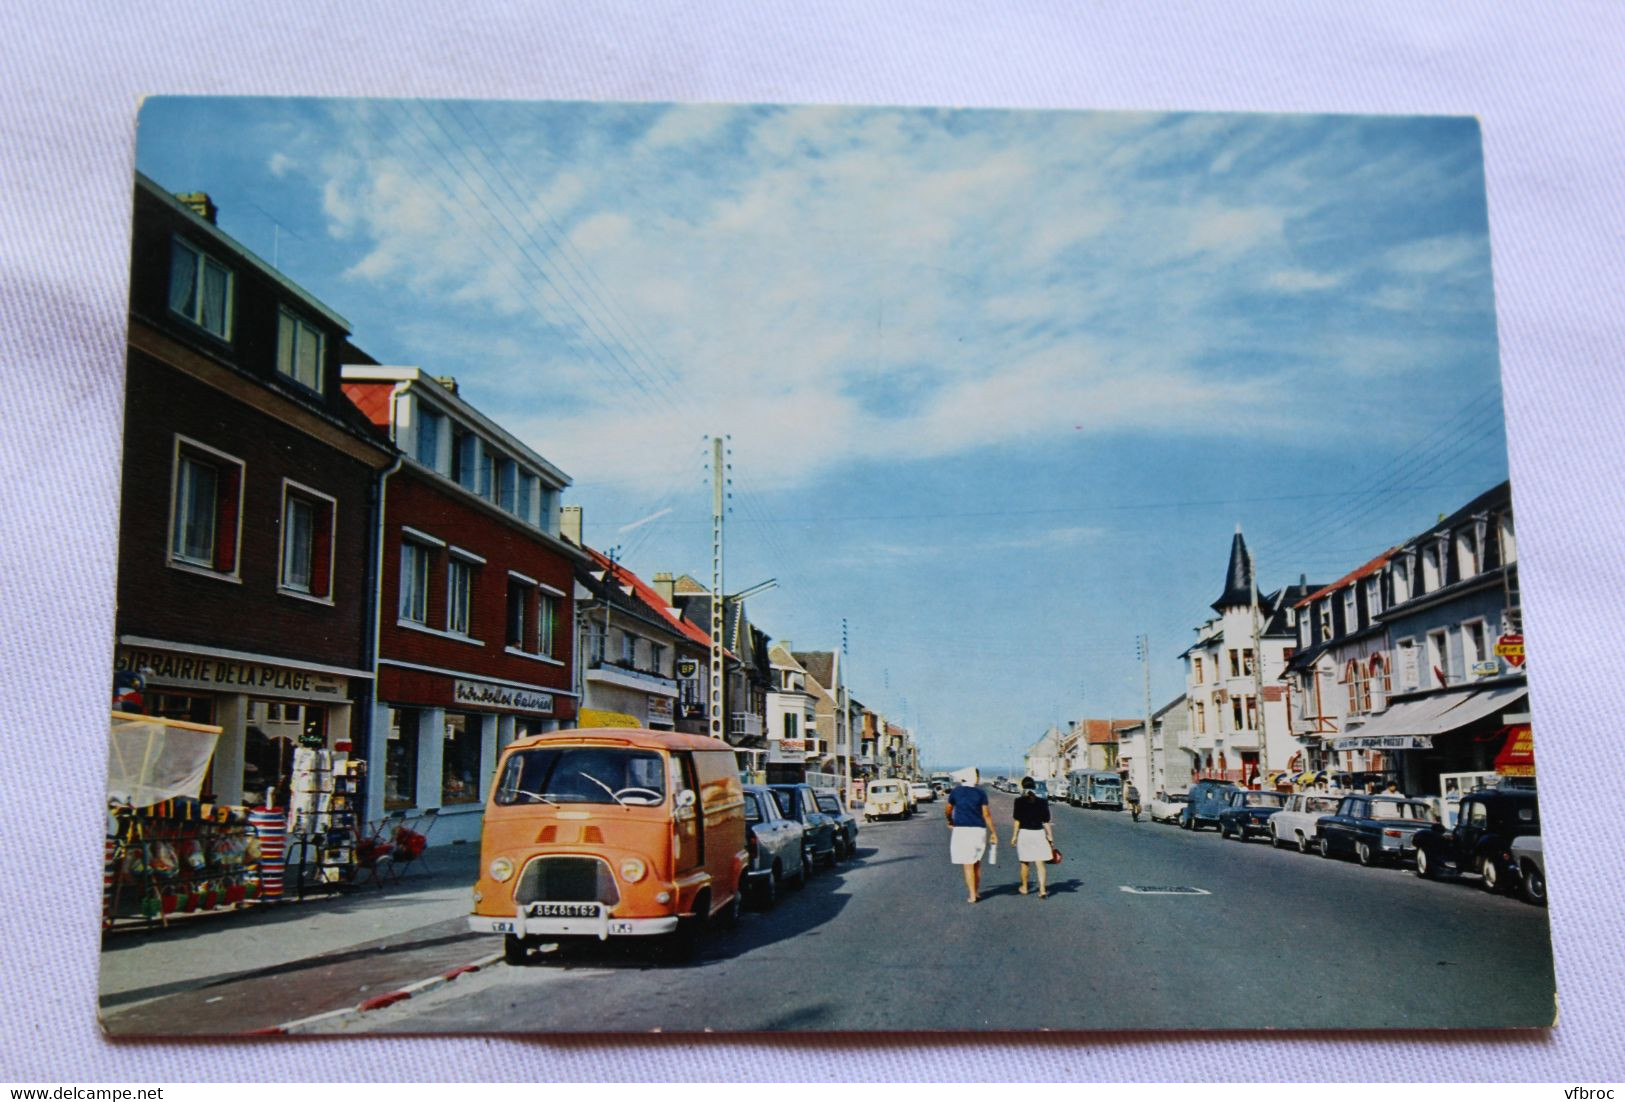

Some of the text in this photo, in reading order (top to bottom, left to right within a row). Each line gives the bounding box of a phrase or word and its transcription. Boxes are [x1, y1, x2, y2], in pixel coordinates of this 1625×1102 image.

[213, 661, 234, 684] DE
[236, 664, 257, 686] LA
[258, 667, 311, 691] PLAGE
[681, 664, 695, 674] BP
